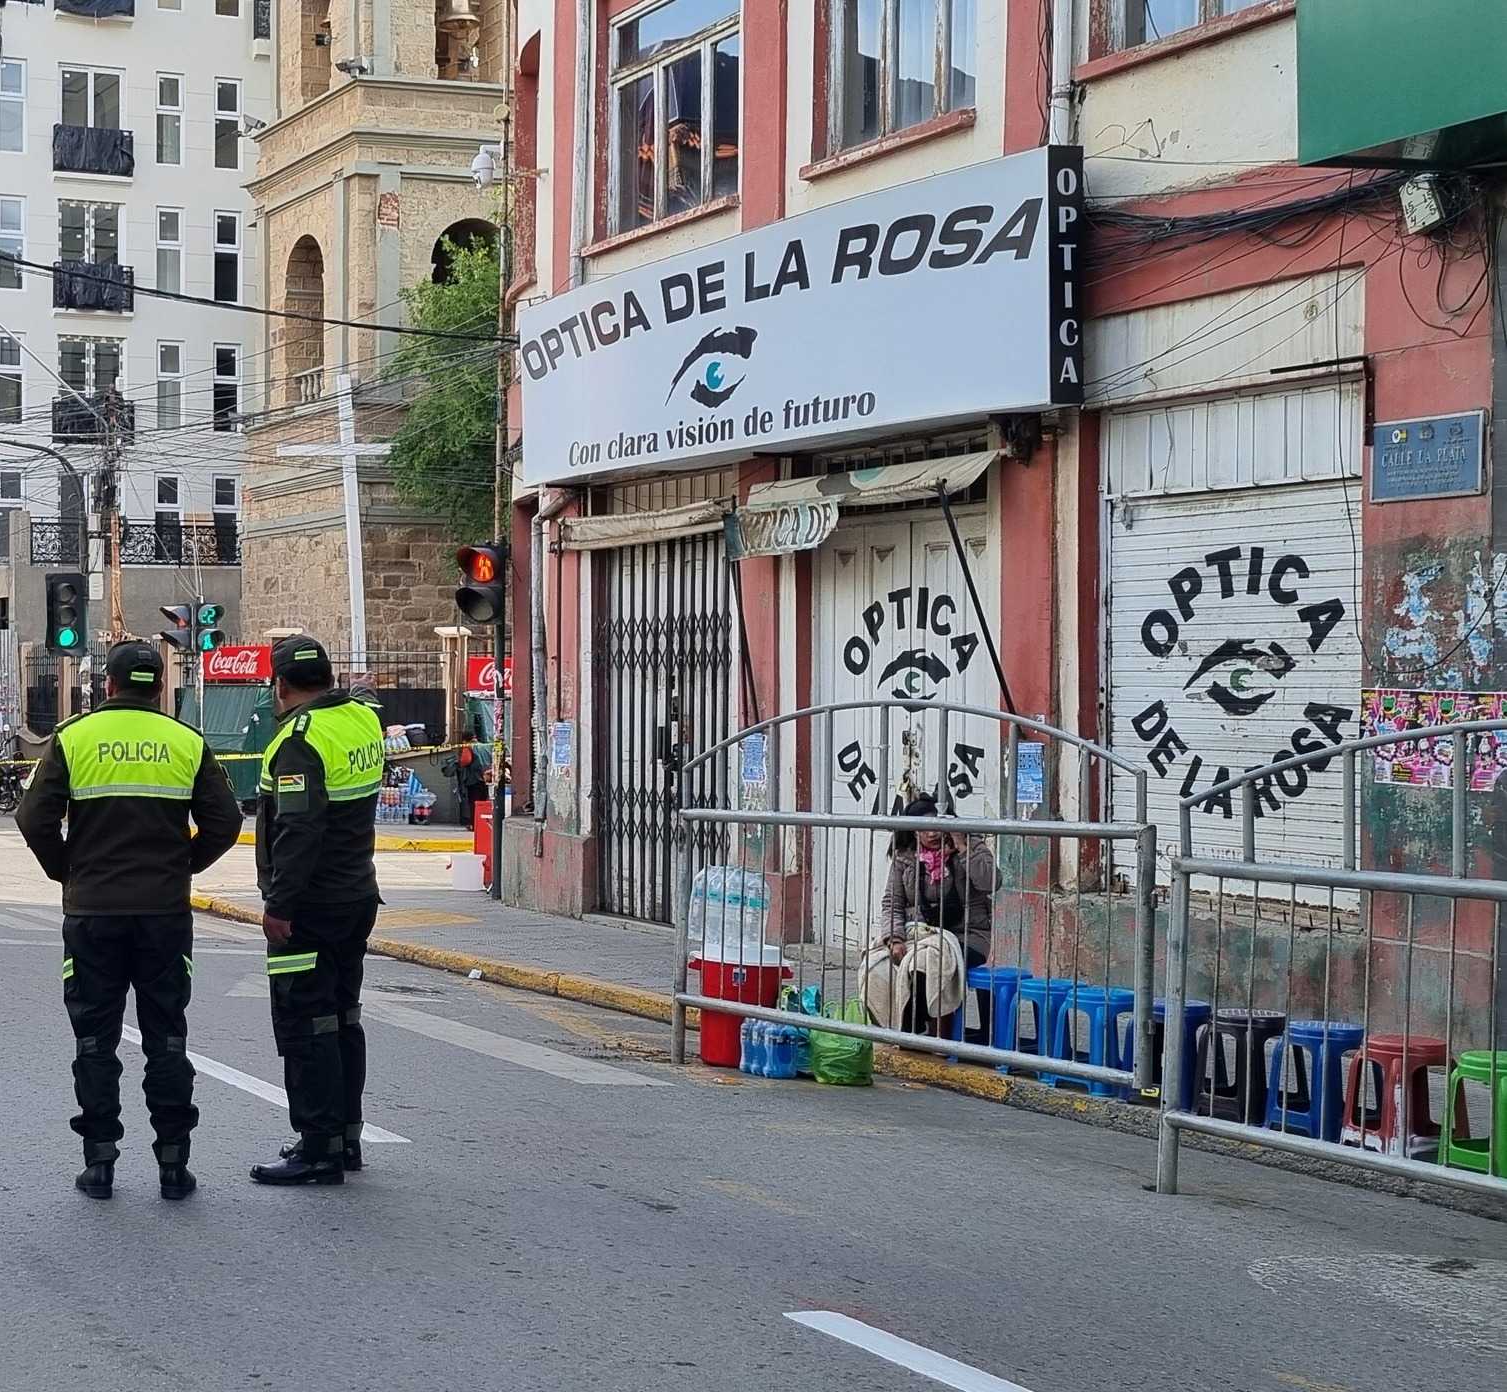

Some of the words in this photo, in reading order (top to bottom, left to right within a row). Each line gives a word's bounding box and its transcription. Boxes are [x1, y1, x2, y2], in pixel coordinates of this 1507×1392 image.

[521, 290, 652, 381] OPTICA
[660, 260, 726, 325] DE
[744, 239, 811, 304] LA
[831, 197, 1044, 285] ROSA
[1057, 167, 1079, 384] OPTICA
[569, 440, 601, 467] Con
[608, 432, 659, 460] clara
[666, 415, 735, 450] visión
[744, 406, 774, 437] de
[783, 391, 877, 430] futuro
[1381, 449, 1413, 468] CALLE
[1437, 446, 1467, 463] PLATA
[844, 587, 979, 676] OPTICA
[1141, 546, 1345, 657] OPTICA
[97, 741, 171, 764] POLICIA
[837, 740, 877, 802] DE
[1131, 700, 1190, 778] DE
[1244, 701, 1354, 818] ROSA
